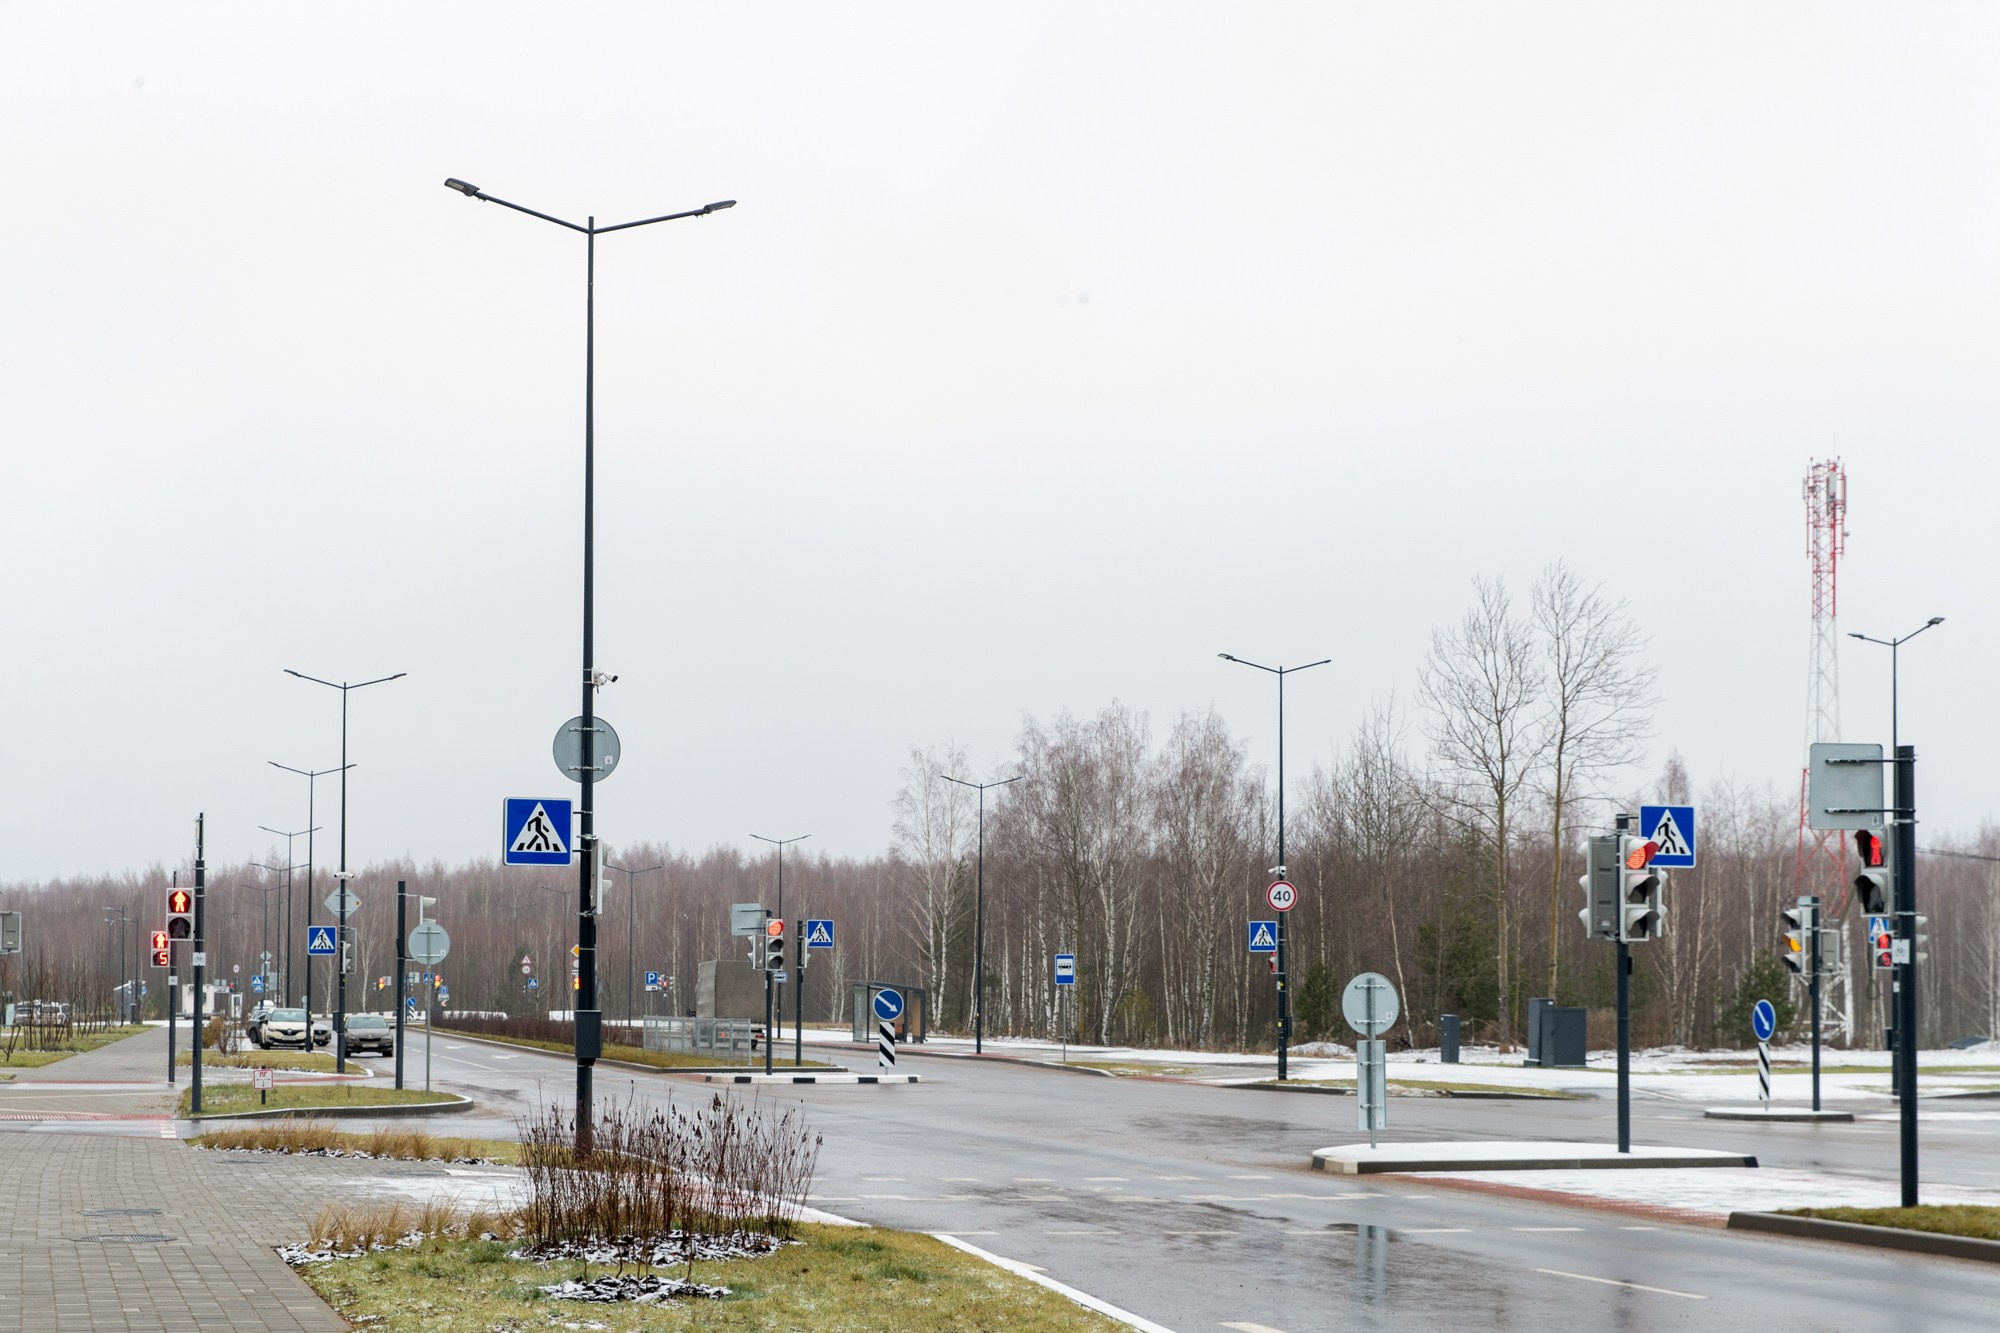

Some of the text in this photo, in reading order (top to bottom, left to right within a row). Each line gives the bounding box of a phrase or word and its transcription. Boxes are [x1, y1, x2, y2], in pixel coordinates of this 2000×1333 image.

[1273, 891, 1291, 902] 40
[160, 952, 167, 964] 5
[1882, 952, 1891, 966] 5
[648, 973, 656, 983] P
